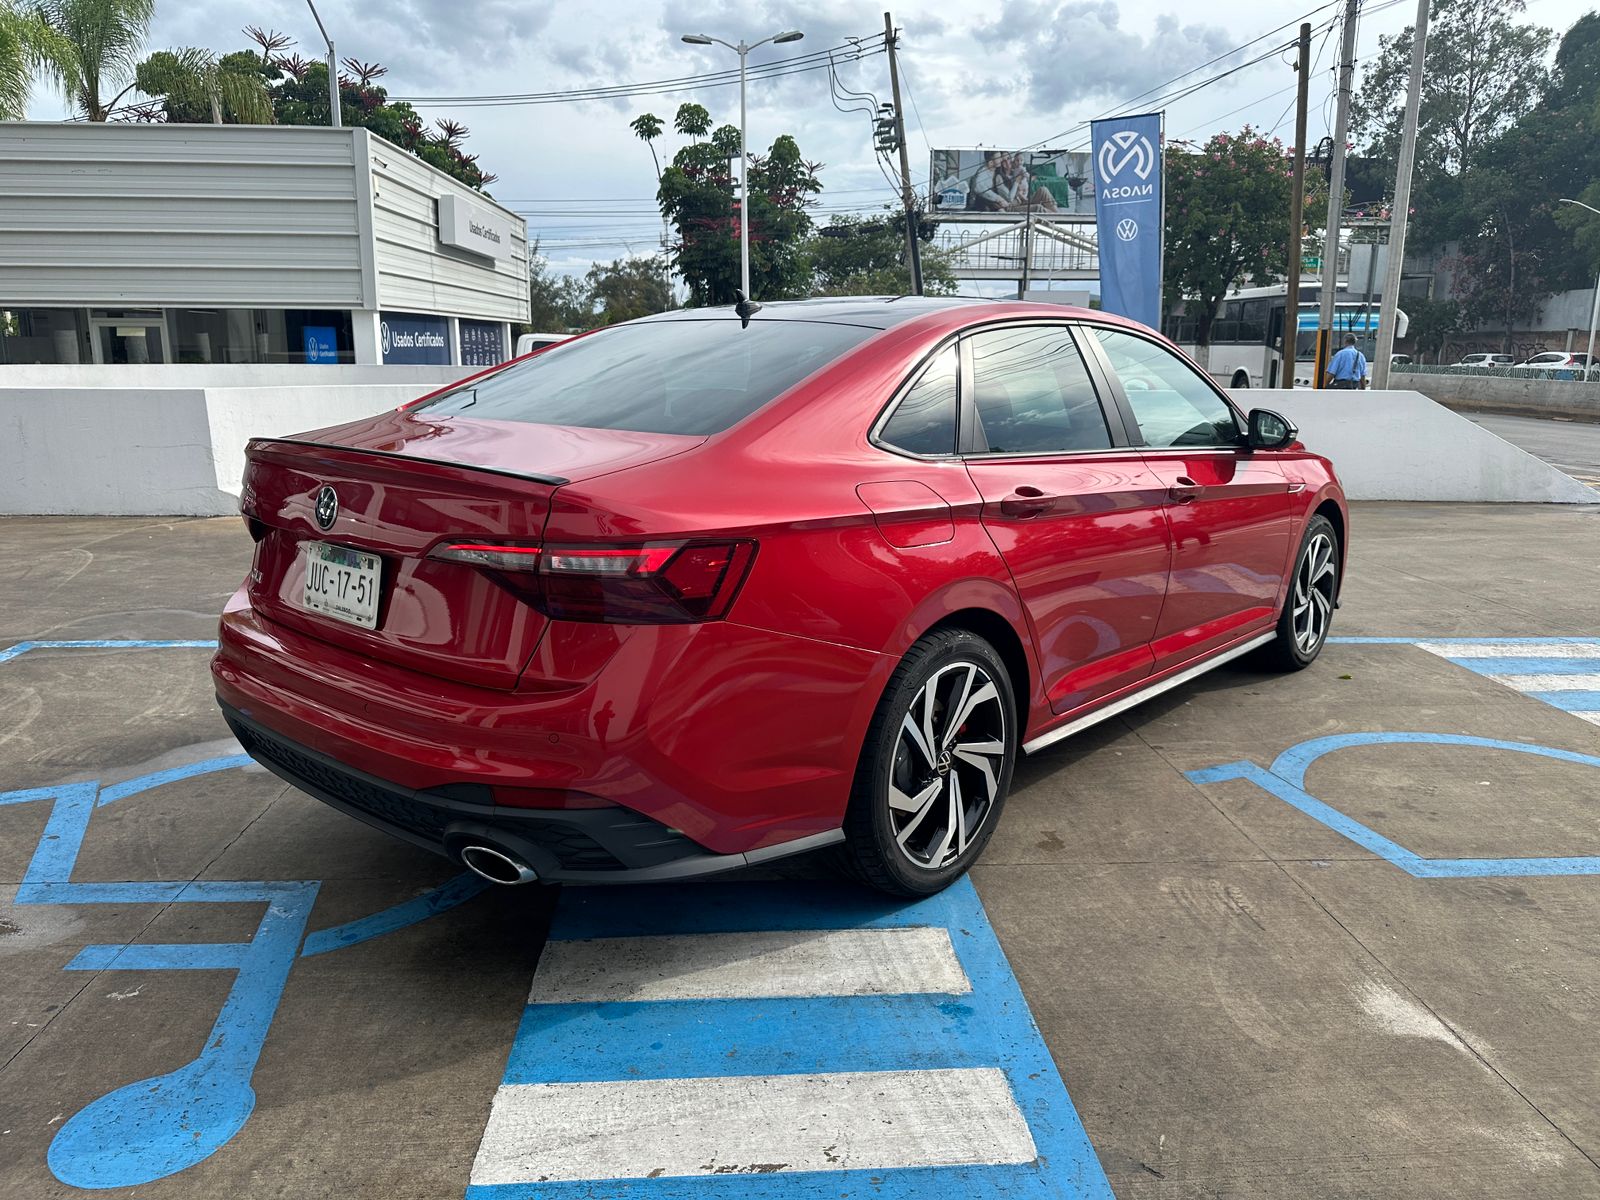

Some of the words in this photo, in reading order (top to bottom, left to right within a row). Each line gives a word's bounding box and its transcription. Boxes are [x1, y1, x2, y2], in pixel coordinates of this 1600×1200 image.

[392, 330, 414, 348] Usados
[414, 331, 444, 348] Certificados
[306, 561, 374, 606] JUC-17-51
